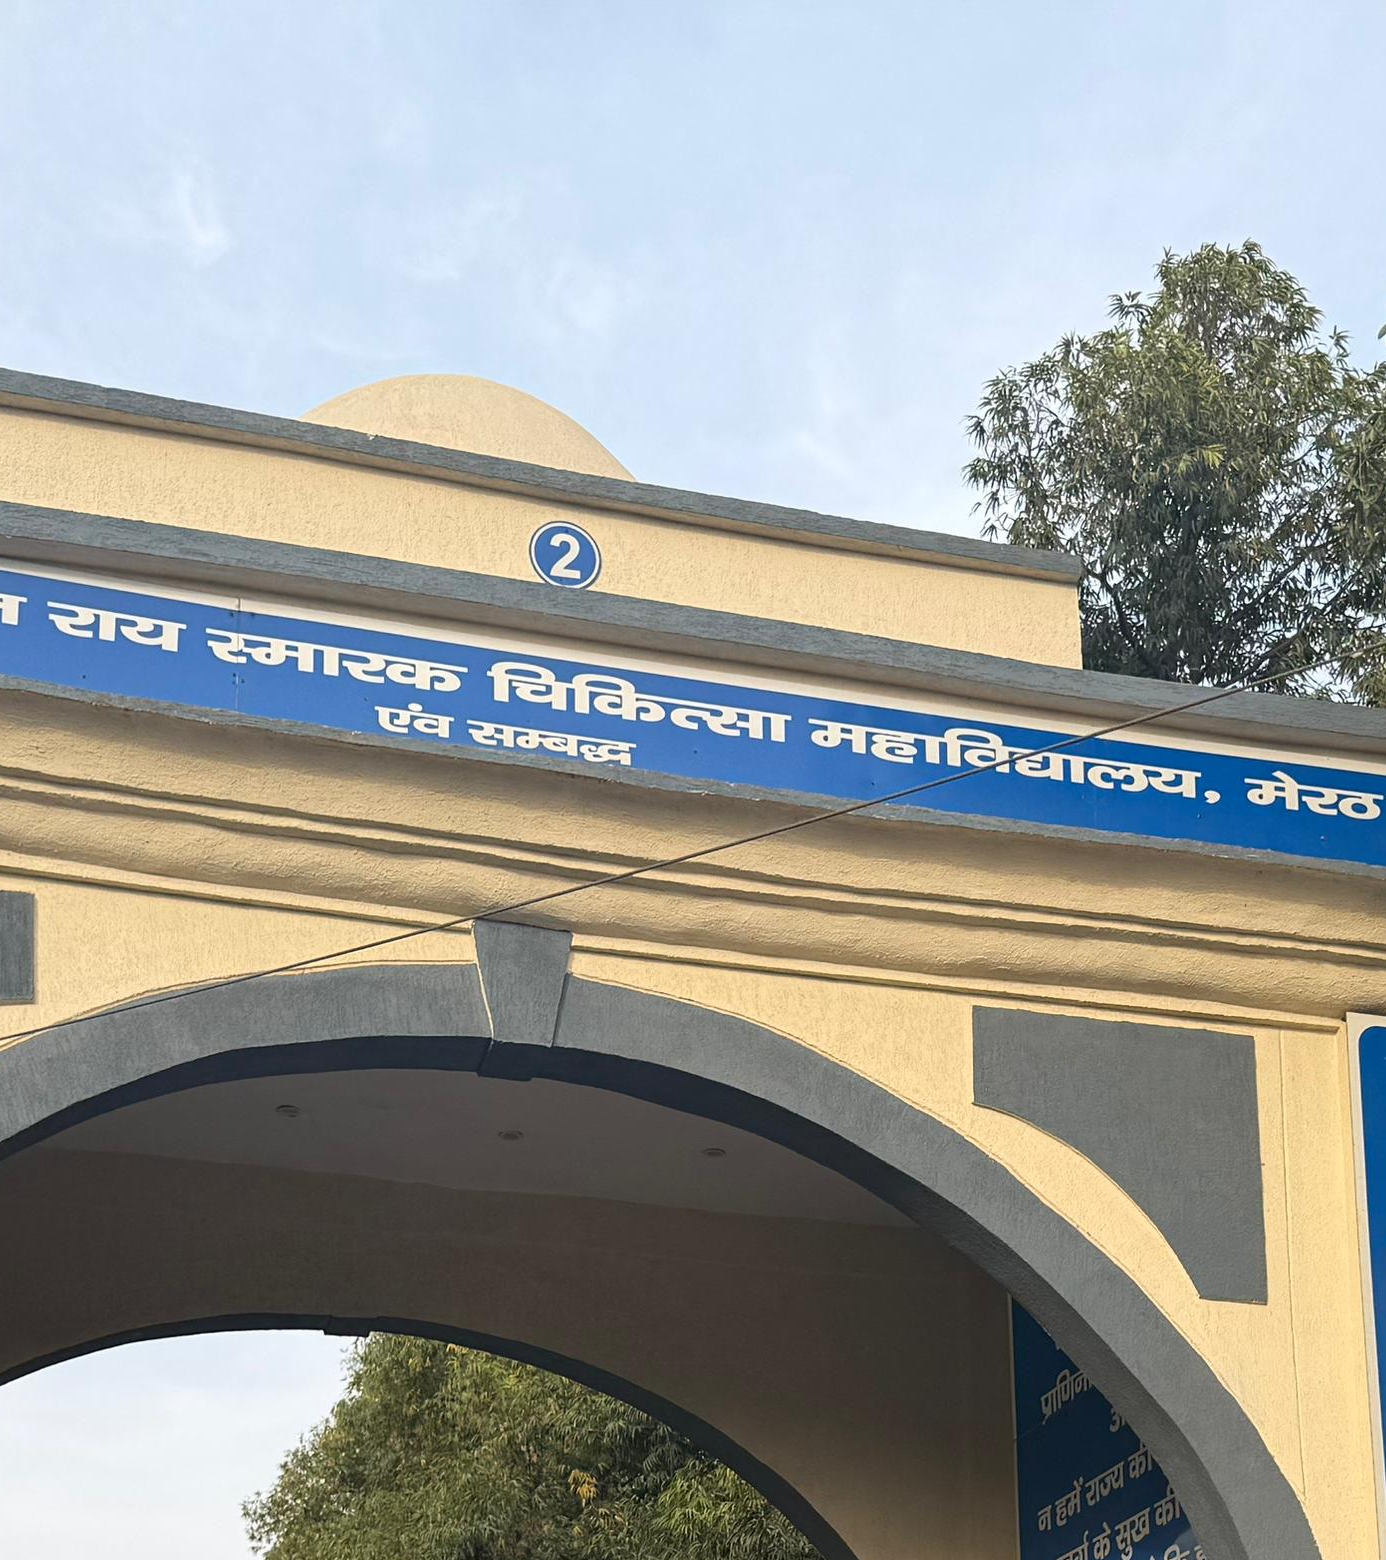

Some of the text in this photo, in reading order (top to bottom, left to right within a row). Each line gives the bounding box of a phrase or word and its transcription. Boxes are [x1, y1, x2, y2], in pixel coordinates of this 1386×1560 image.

[547, 533, 583, 580] 2
[47, 600, 185, 652] राय
[204, 627, 468, 693] स्मारक
[490, 661, 790, 744] चिकित्सा
[809, 719, 1220, 805] महाविद्यालय,
[1244, 769, 1385, 820] मेरठ
[1038, 1505, 1051, 1531] न
[1055, 1476, 1083, 1527] हमें
[1085, 1461, 1125, 1506] राज्य
[1093, 1522, 1111, 1560] के
[1115, 1507, 1150, 1560] सुख
[1154, 1485, 1180, 1526] की
